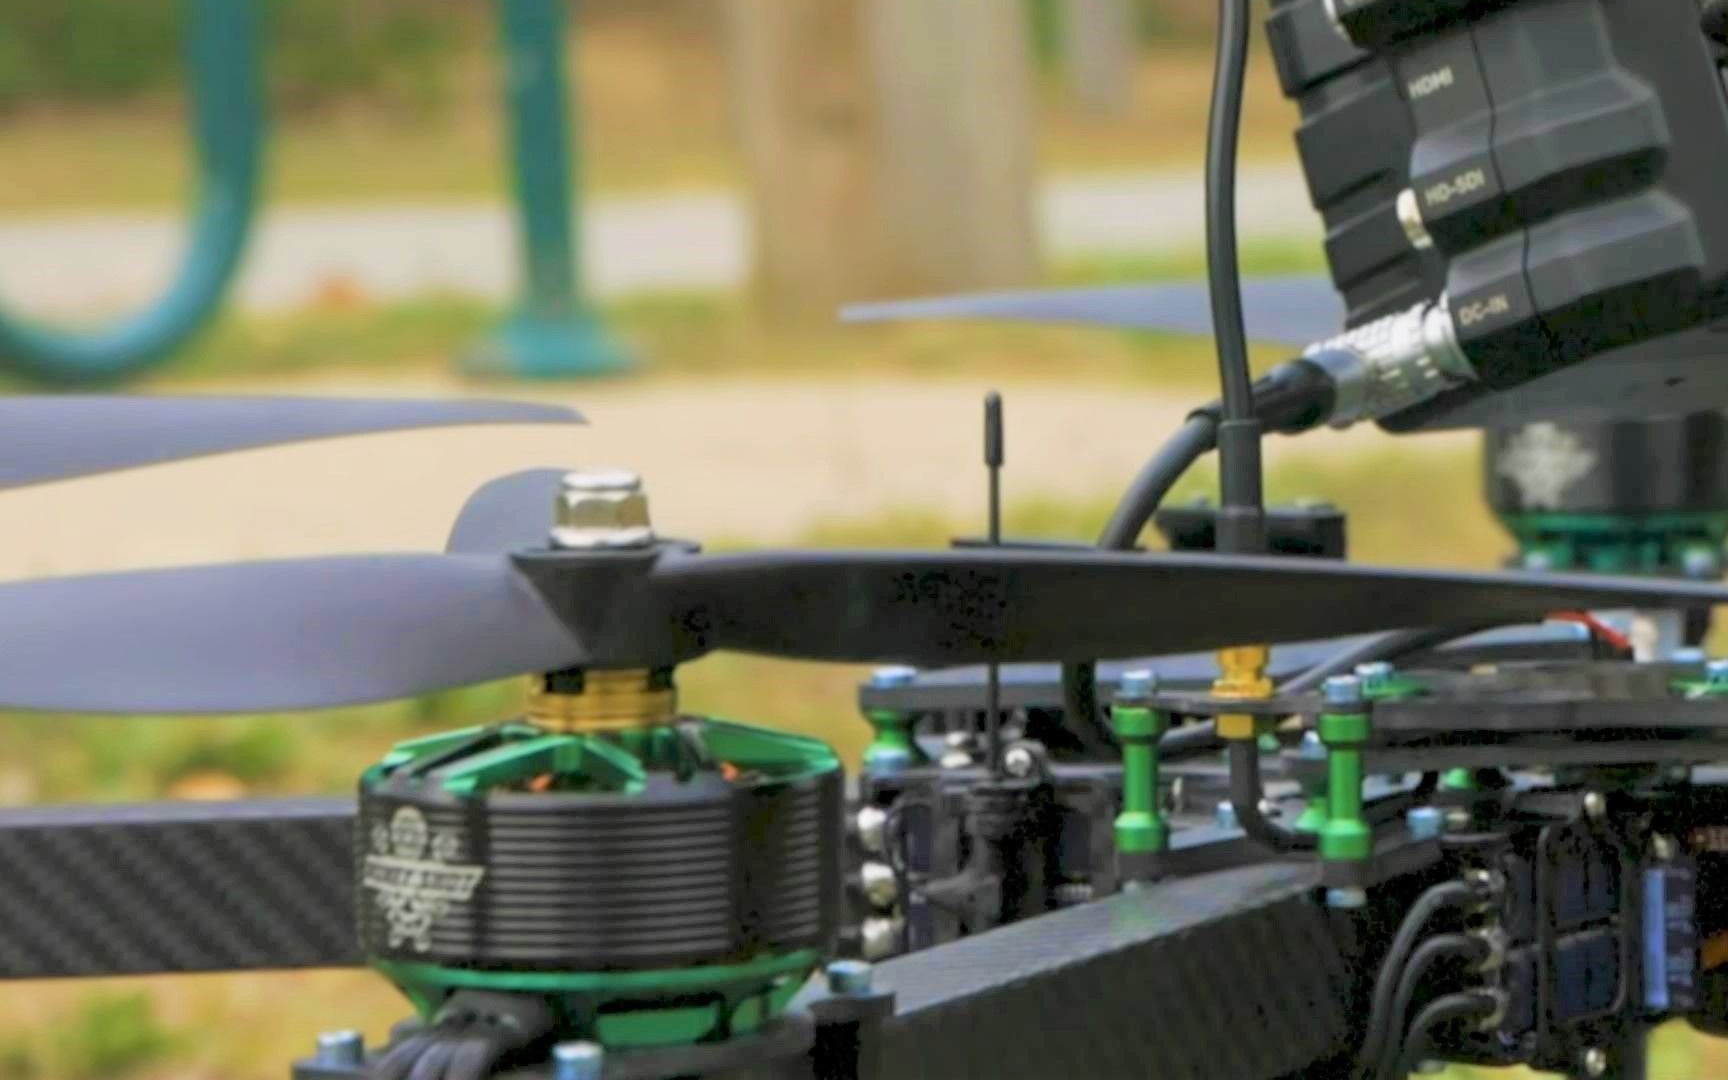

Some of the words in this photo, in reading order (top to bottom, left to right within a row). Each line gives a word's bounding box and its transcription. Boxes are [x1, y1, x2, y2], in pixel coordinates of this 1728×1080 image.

[1408, 66, 1454, 98] HDMI
[1424, 169, 1486, 205] HD-SDI
[1458, 293, 1510, 326] DC-IN
